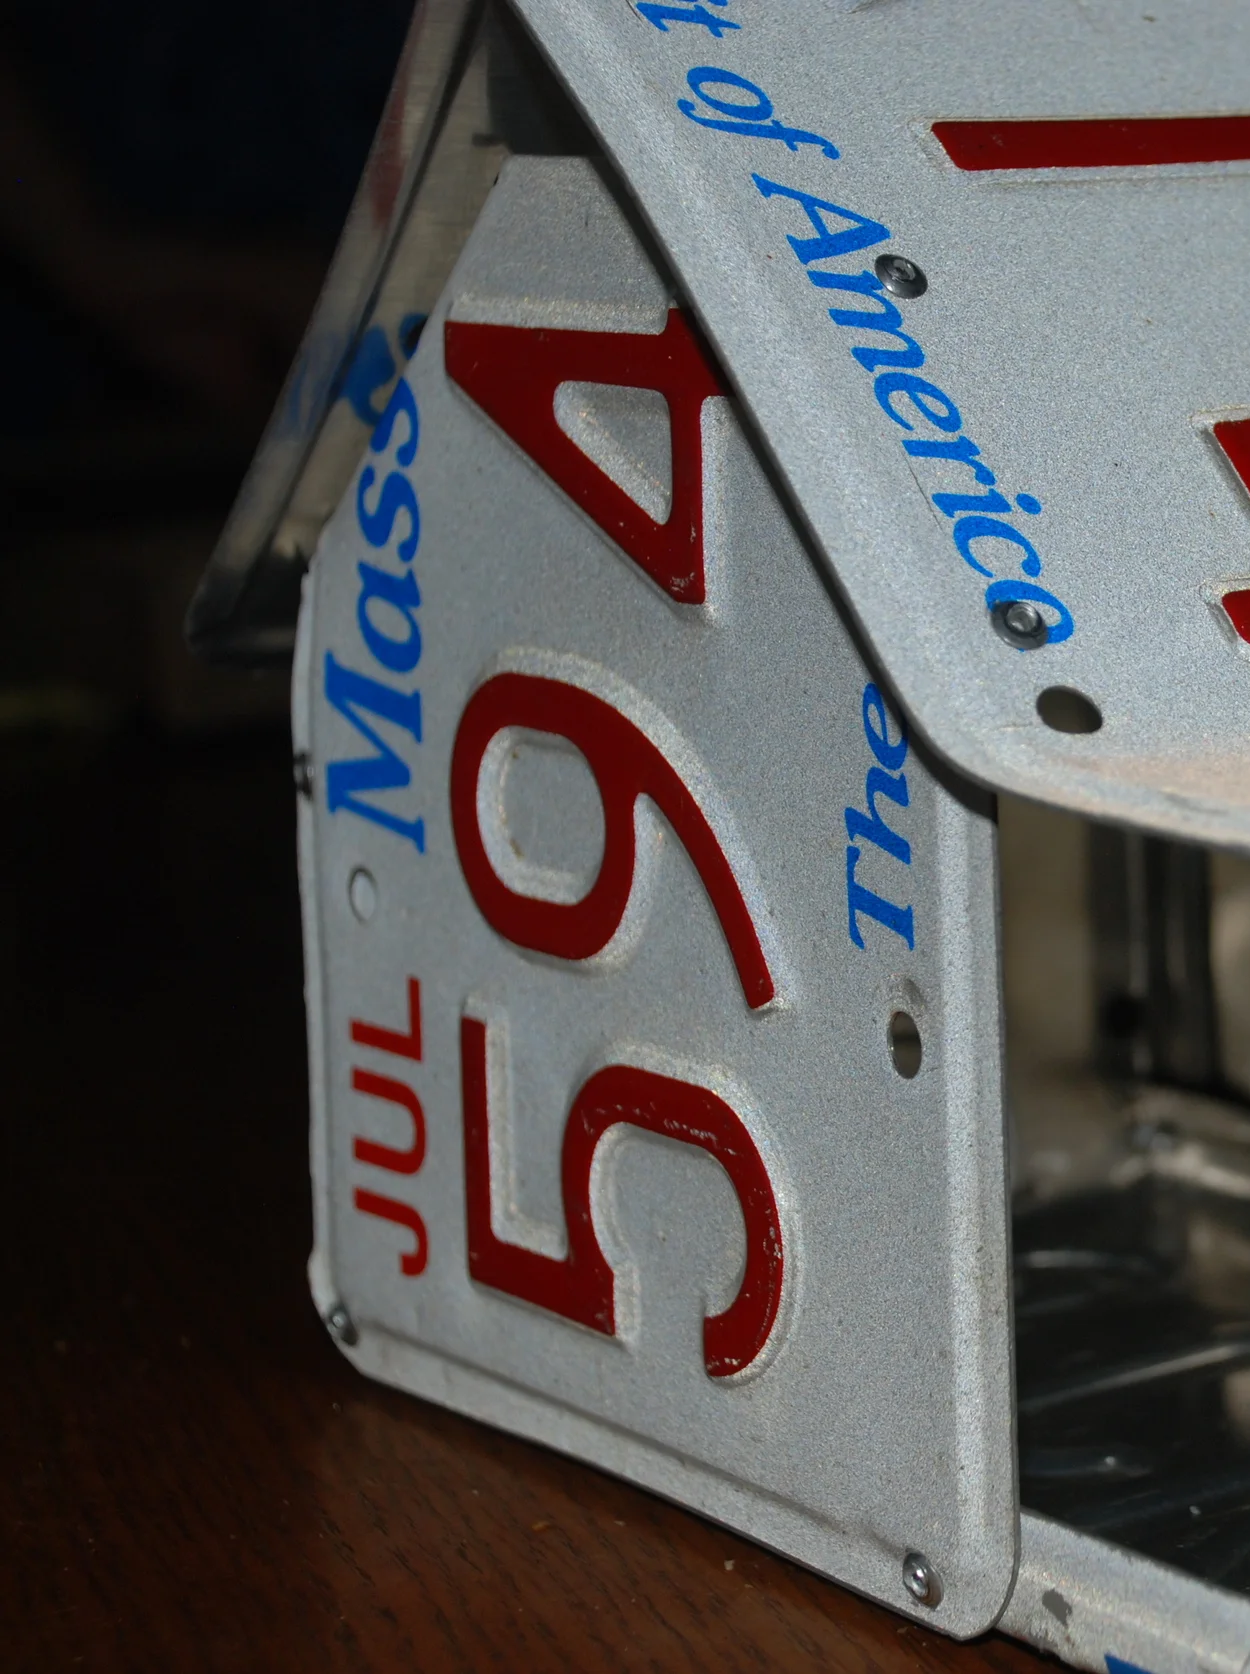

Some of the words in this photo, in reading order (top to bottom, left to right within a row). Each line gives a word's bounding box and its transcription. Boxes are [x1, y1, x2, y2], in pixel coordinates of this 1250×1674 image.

[676, 65, 841, 161] of
[444, 307, 785, 1377] 594
[844, 682, 915, 951] The
[351, 977, 429, 1278] JUL
